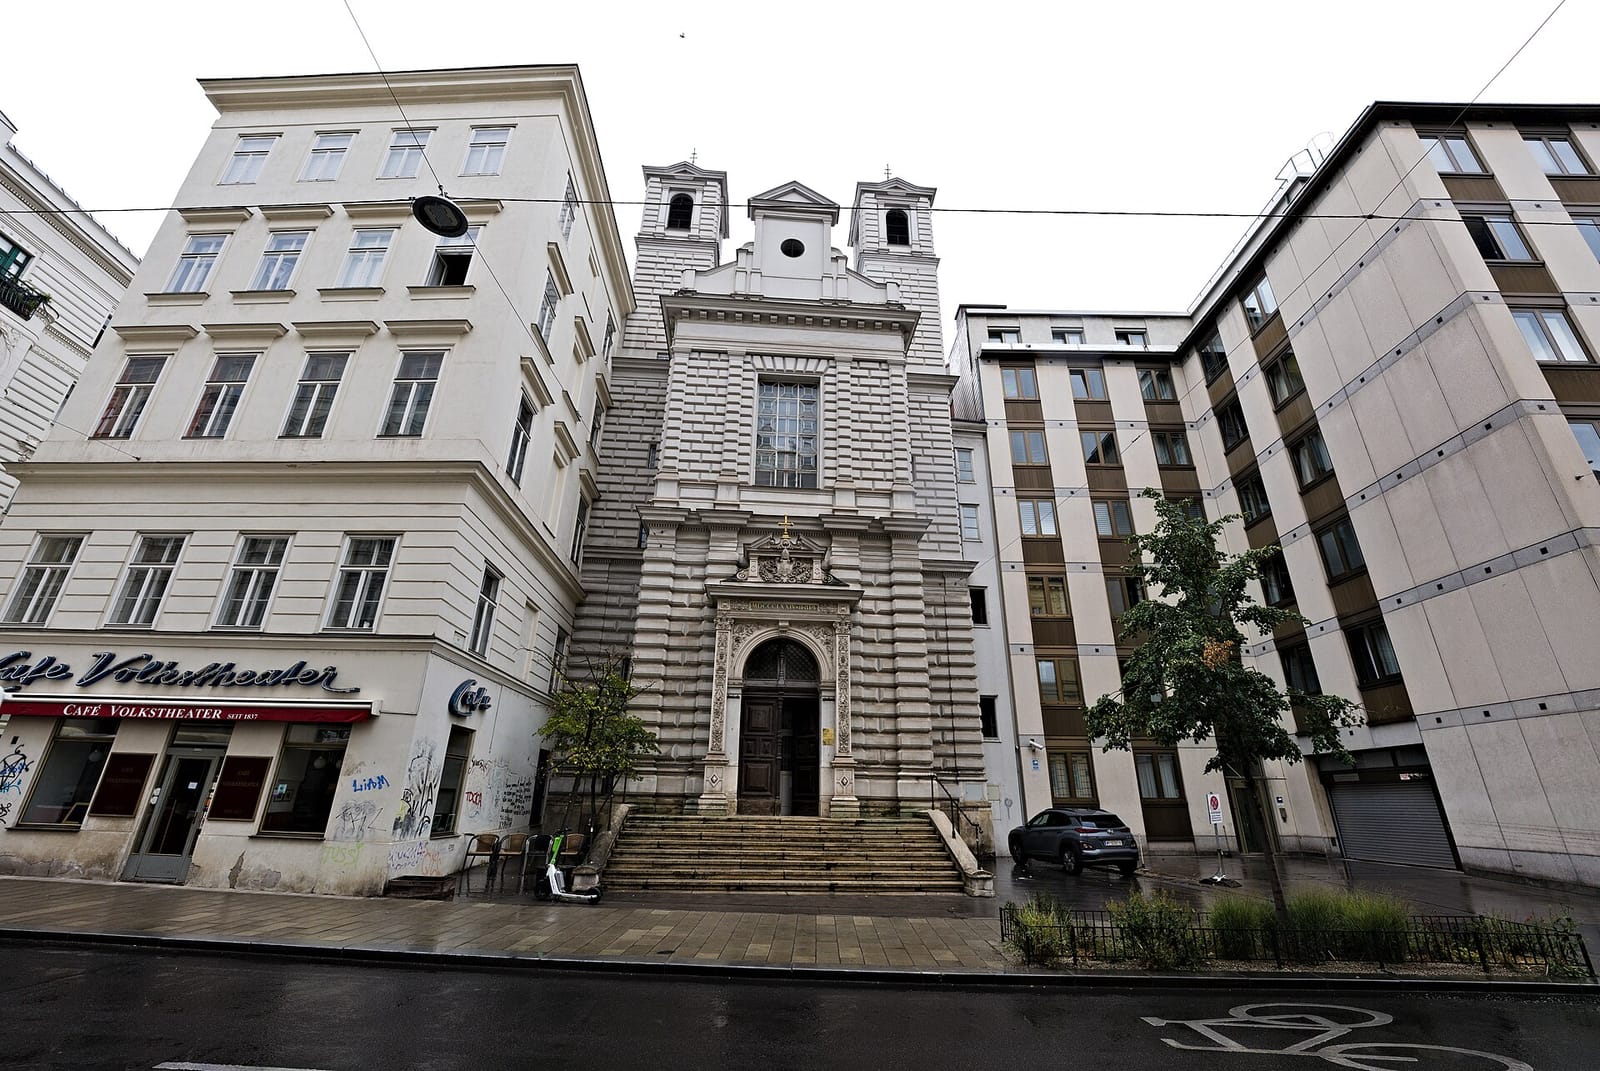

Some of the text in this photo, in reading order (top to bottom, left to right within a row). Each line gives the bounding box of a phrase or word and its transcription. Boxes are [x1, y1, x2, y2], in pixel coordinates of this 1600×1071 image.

[75, 651, 361, 695] Volkstheater
[63, 703, 102, 716] CAFÉ
[110, 705, 223, 720] VOLKSTHEATER
